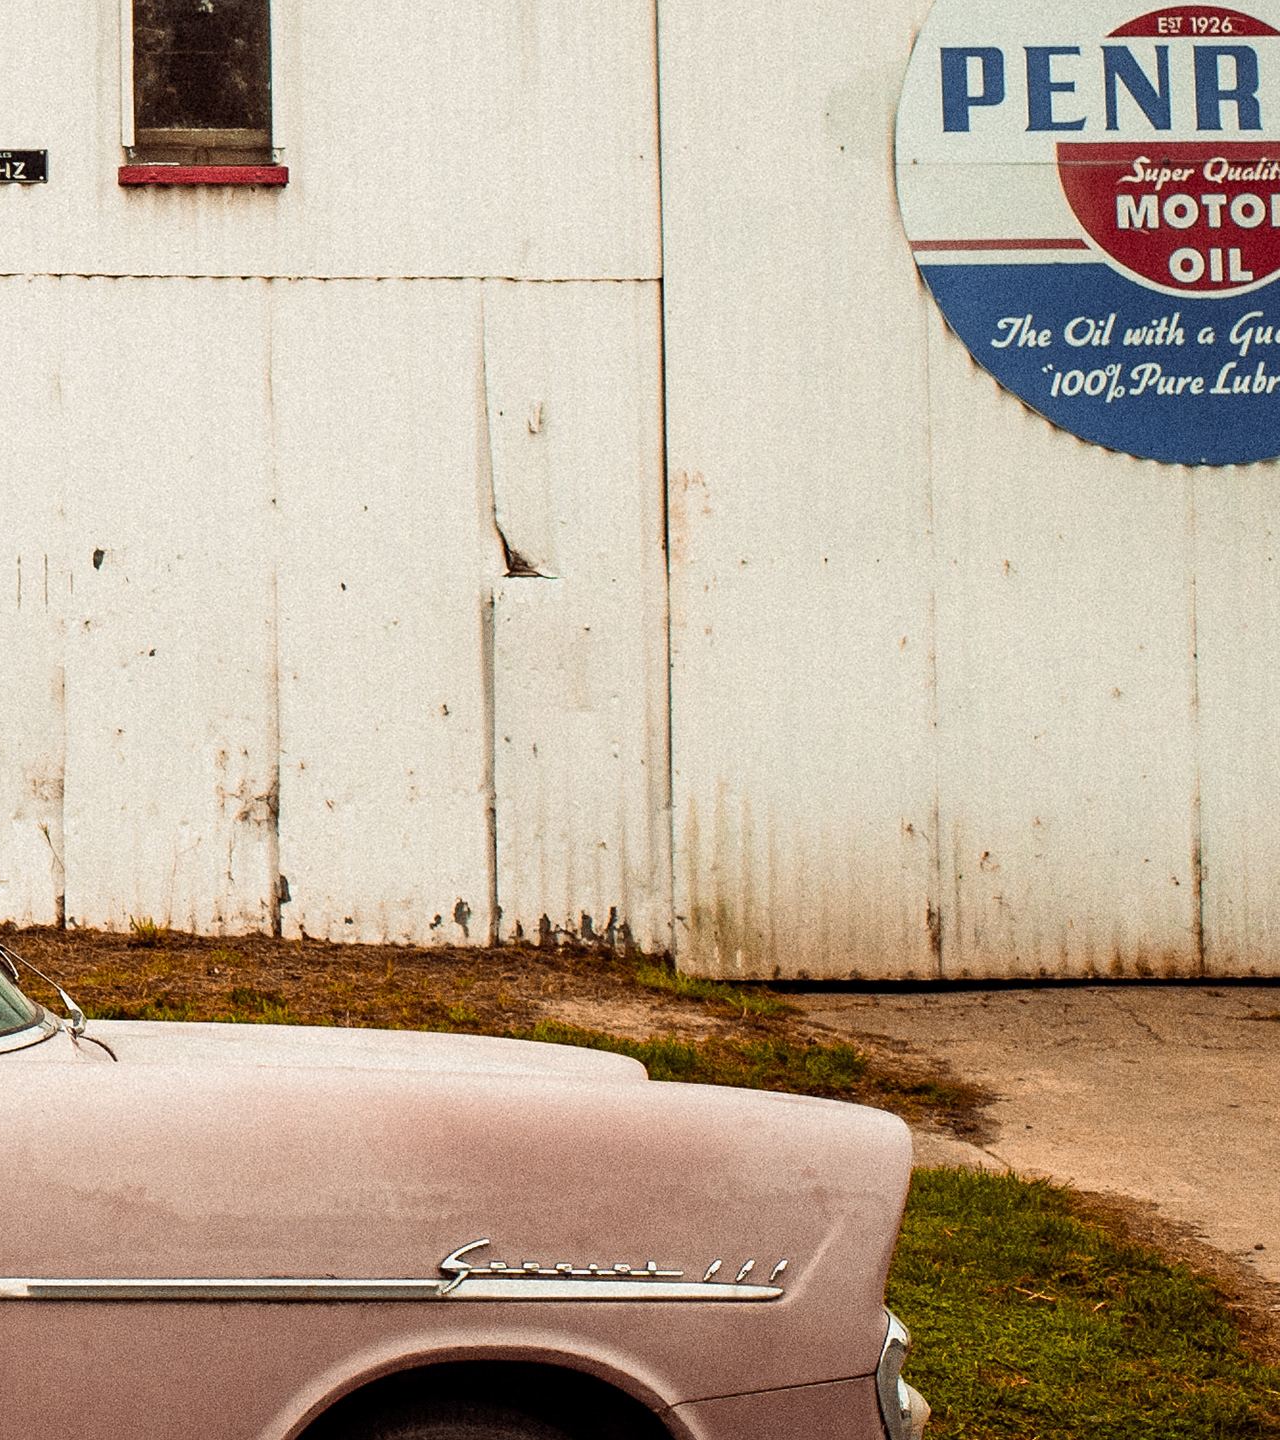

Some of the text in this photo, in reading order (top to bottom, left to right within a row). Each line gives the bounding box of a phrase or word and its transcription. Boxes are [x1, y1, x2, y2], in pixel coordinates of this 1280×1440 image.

[1189, 16, 1233, 34] 1926
[939, 44, 1264, 132] PENR
[1116, 155, 1280, 191] Super Qualit
[1116, 193, 1280, 231] MOTO
[1168, 246, 1254, 284] OIL
[990, 313, 1052, 349] The
[1064, 312, 1118, 347] Oil
[1122, 311, 1186, 346] with
[1196, 326, 1216, 346] a
[1129, 362, 1205, 396] Pure
